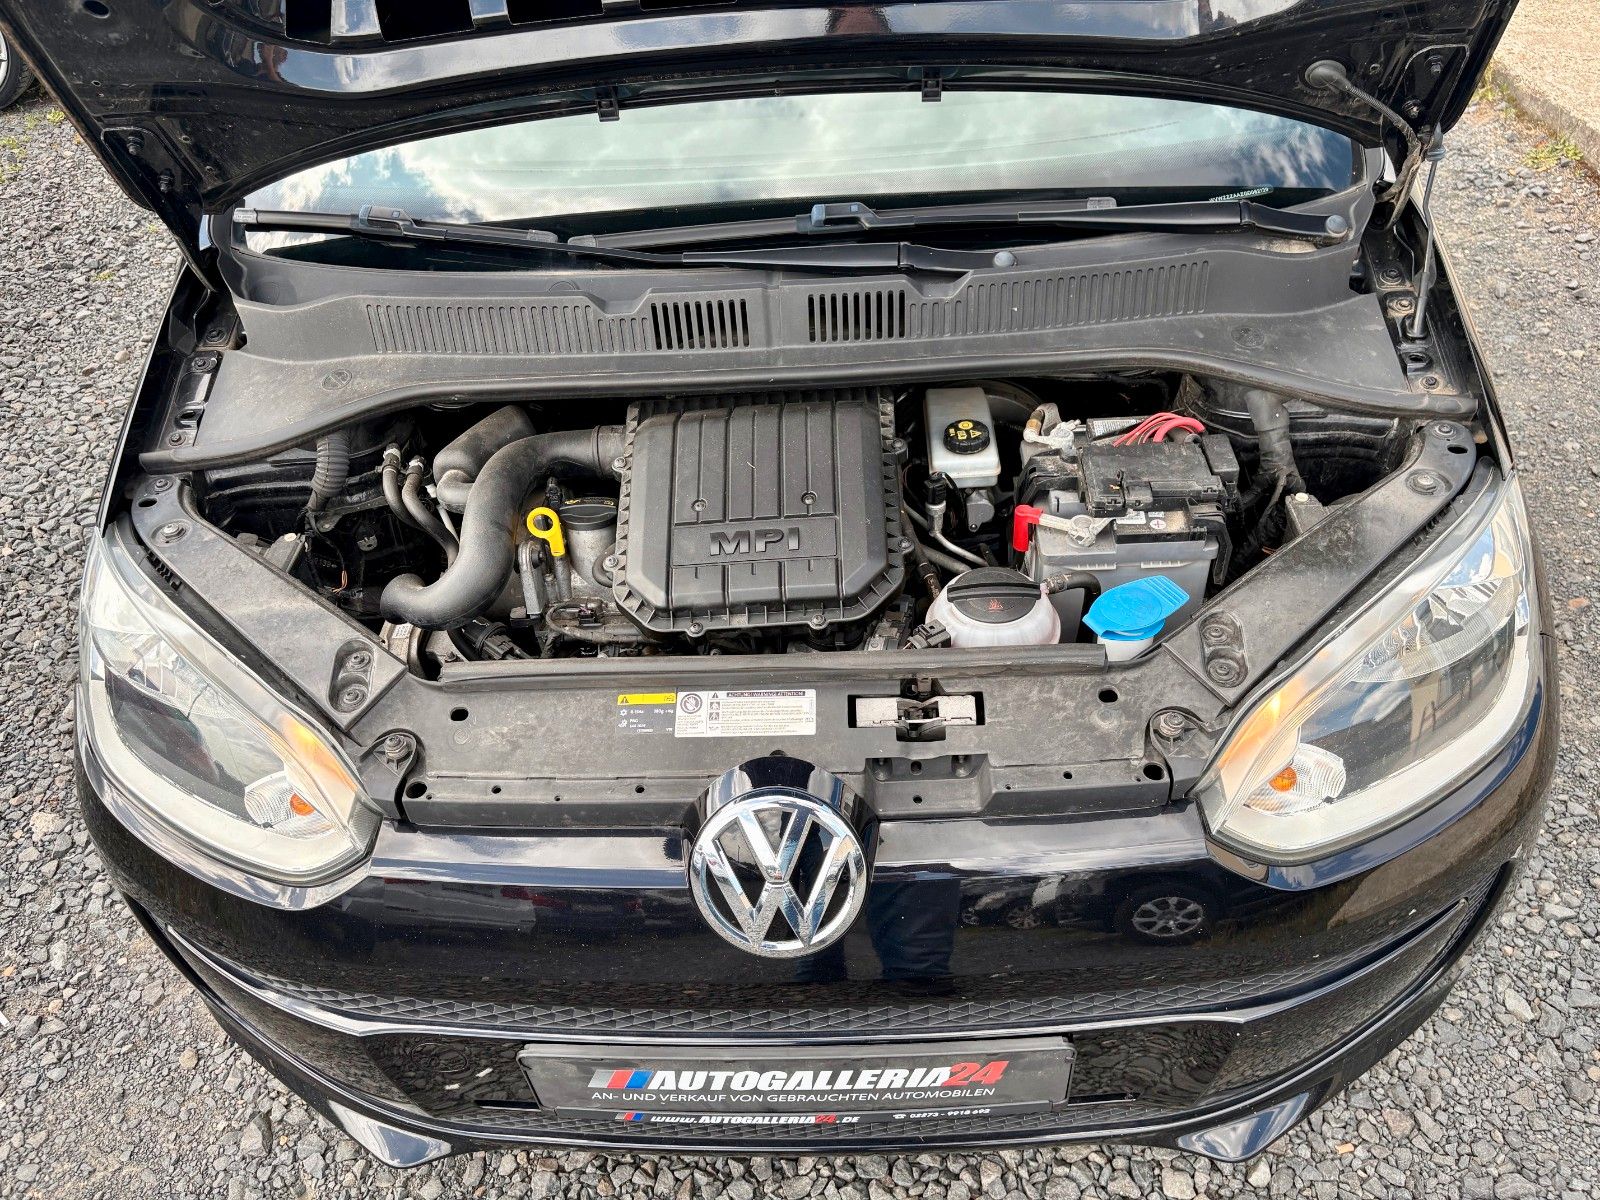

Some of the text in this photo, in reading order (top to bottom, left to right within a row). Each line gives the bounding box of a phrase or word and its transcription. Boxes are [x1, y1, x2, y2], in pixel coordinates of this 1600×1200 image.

[709, 526, 800, 556] MPI
[647, 1060, 1010, 1091] AUTOGALLERIA24
[591, 1087, 996, 1103] AN- UND VERKAUF VON GEBRAUCHTEN AUTOMOBILEN
